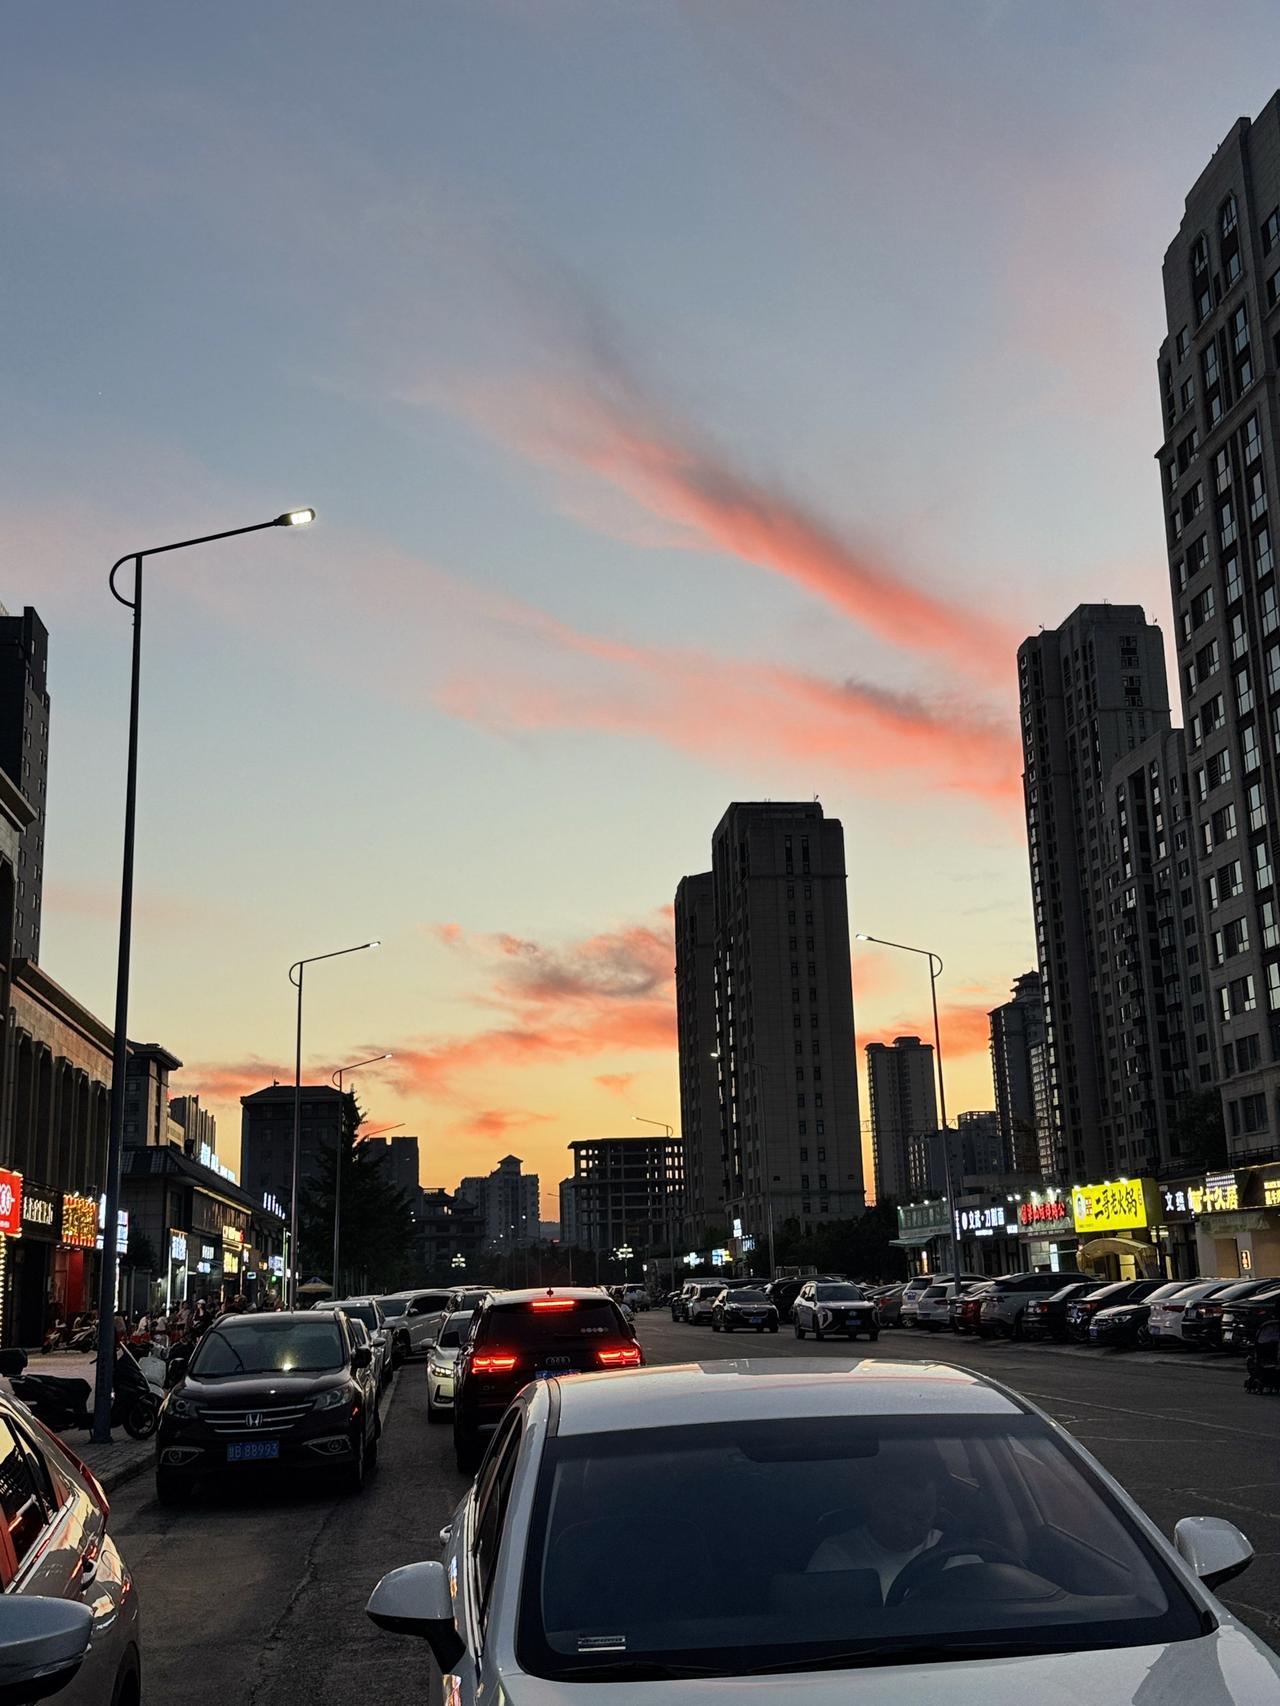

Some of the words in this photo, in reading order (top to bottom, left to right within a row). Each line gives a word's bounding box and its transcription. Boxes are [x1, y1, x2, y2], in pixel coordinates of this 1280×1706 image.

[1094, 1186, 1138, 1220] 二哥老火锅
